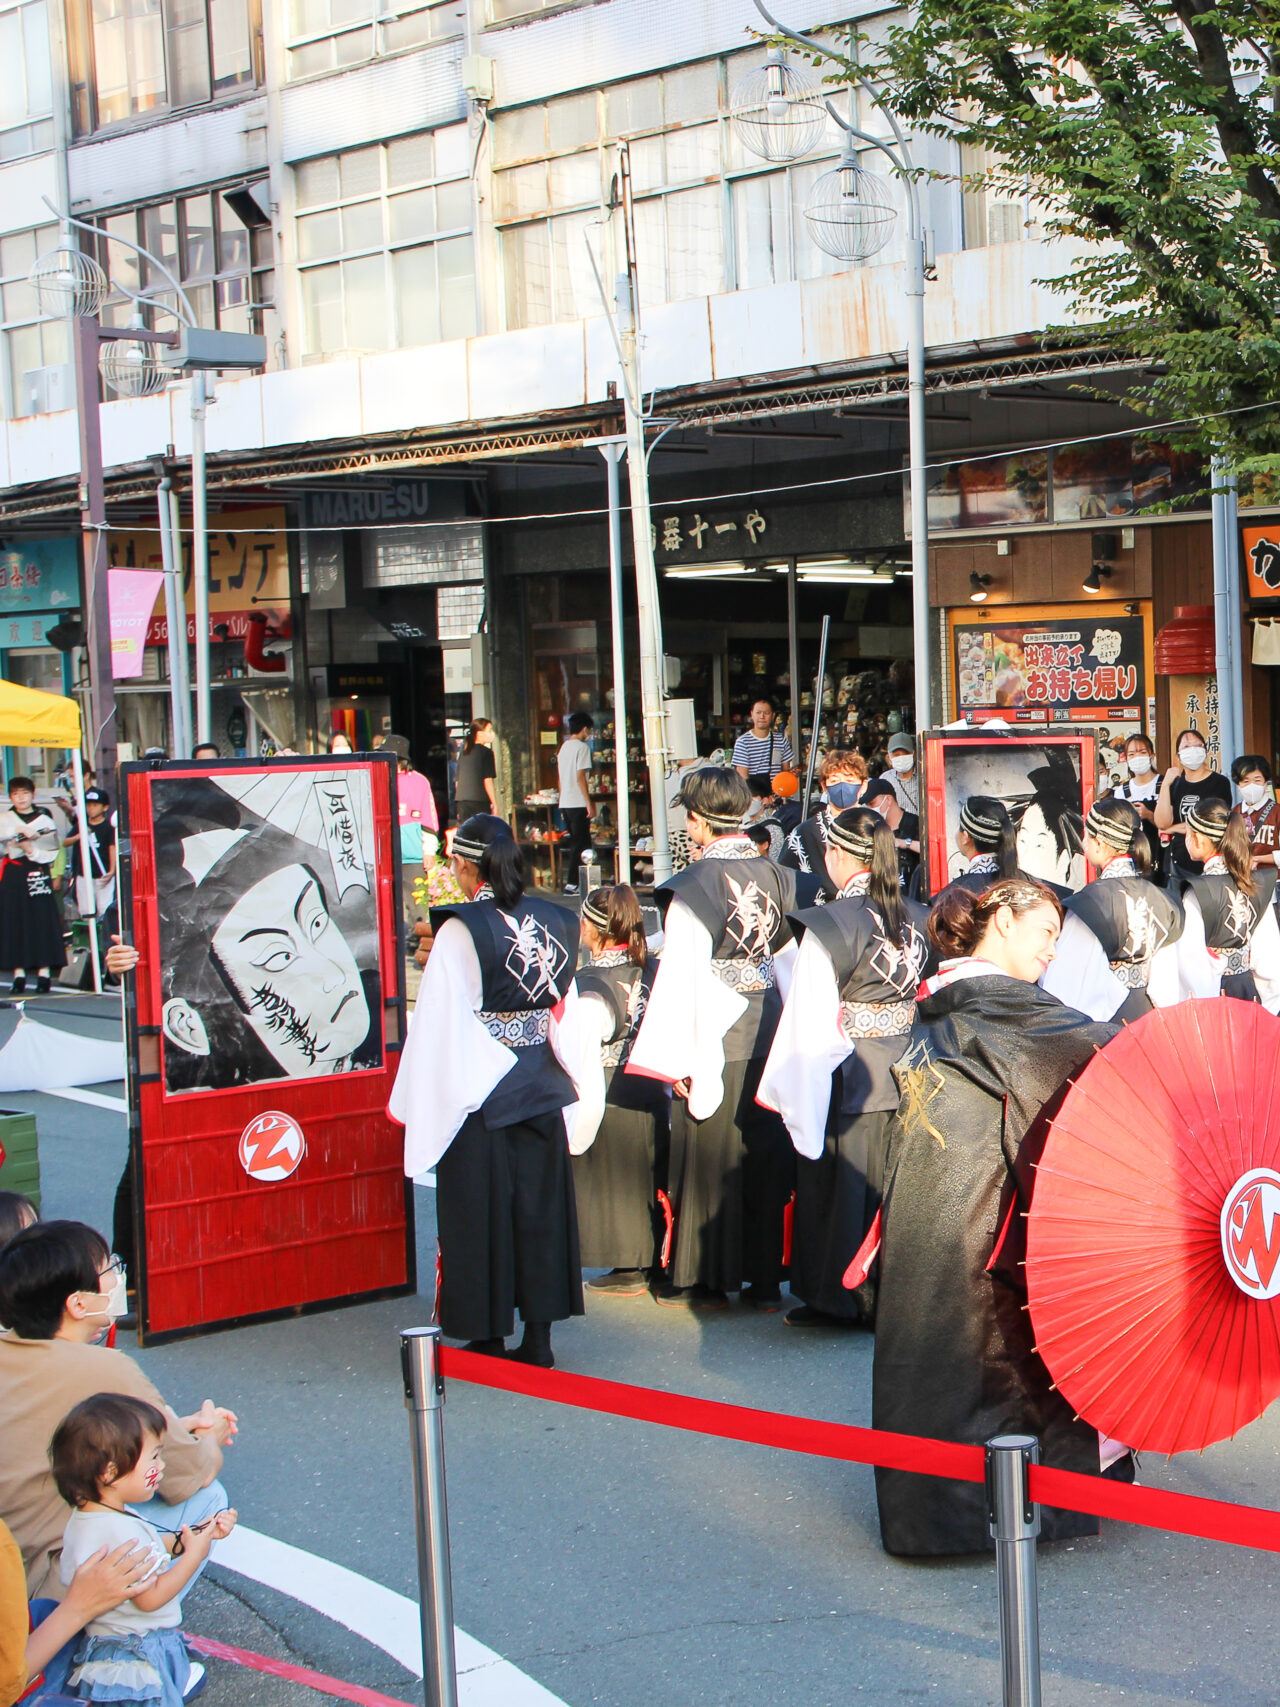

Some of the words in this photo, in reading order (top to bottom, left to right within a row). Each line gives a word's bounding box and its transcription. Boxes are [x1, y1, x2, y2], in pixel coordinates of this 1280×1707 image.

[312, 483, 429, 525] MARUESU
[1024, 644, 1085, 668] 出来立て
[1026, 665, 1137, 702] お持ち帰り
[1205, 677, 1221, 773] お持ち帰り
